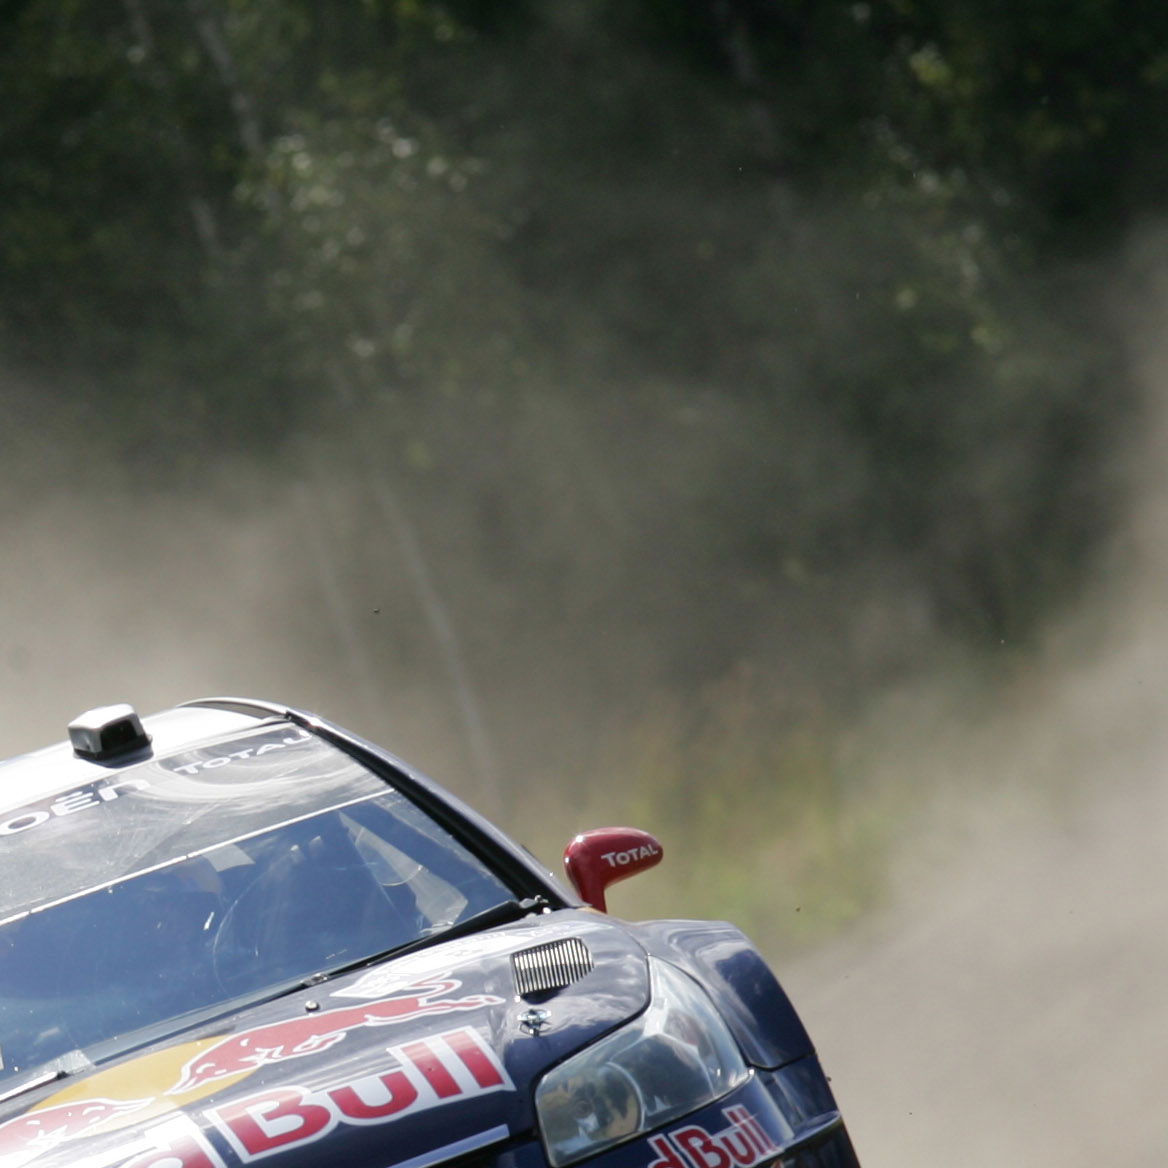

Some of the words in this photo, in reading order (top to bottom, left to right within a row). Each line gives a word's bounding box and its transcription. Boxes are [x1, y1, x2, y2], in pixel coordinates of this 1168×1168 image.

[173, 729, 313, 775] TOTAL
[600, 844, 659, 868] TOTAL
[206, 1026, 514, 1162] Bull
